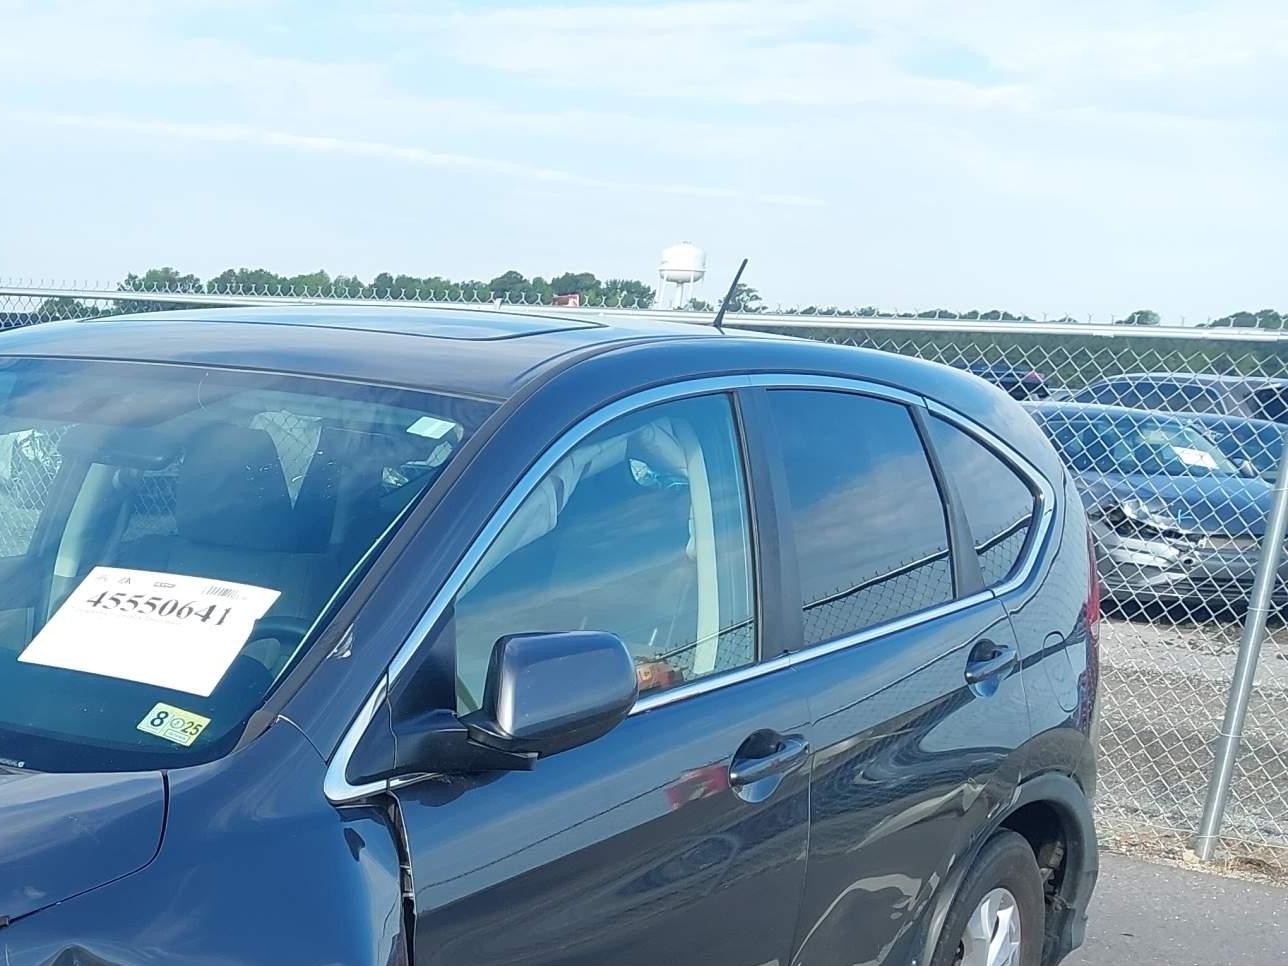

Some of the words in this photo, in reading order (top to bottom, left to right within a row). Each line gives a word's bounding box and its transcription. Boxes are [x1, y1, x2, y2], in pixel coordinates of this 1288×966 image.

[86, 590, 232, 626] 45550641
[150, 710, 169, 727] 8
[181, 721, 203, 736] 25
